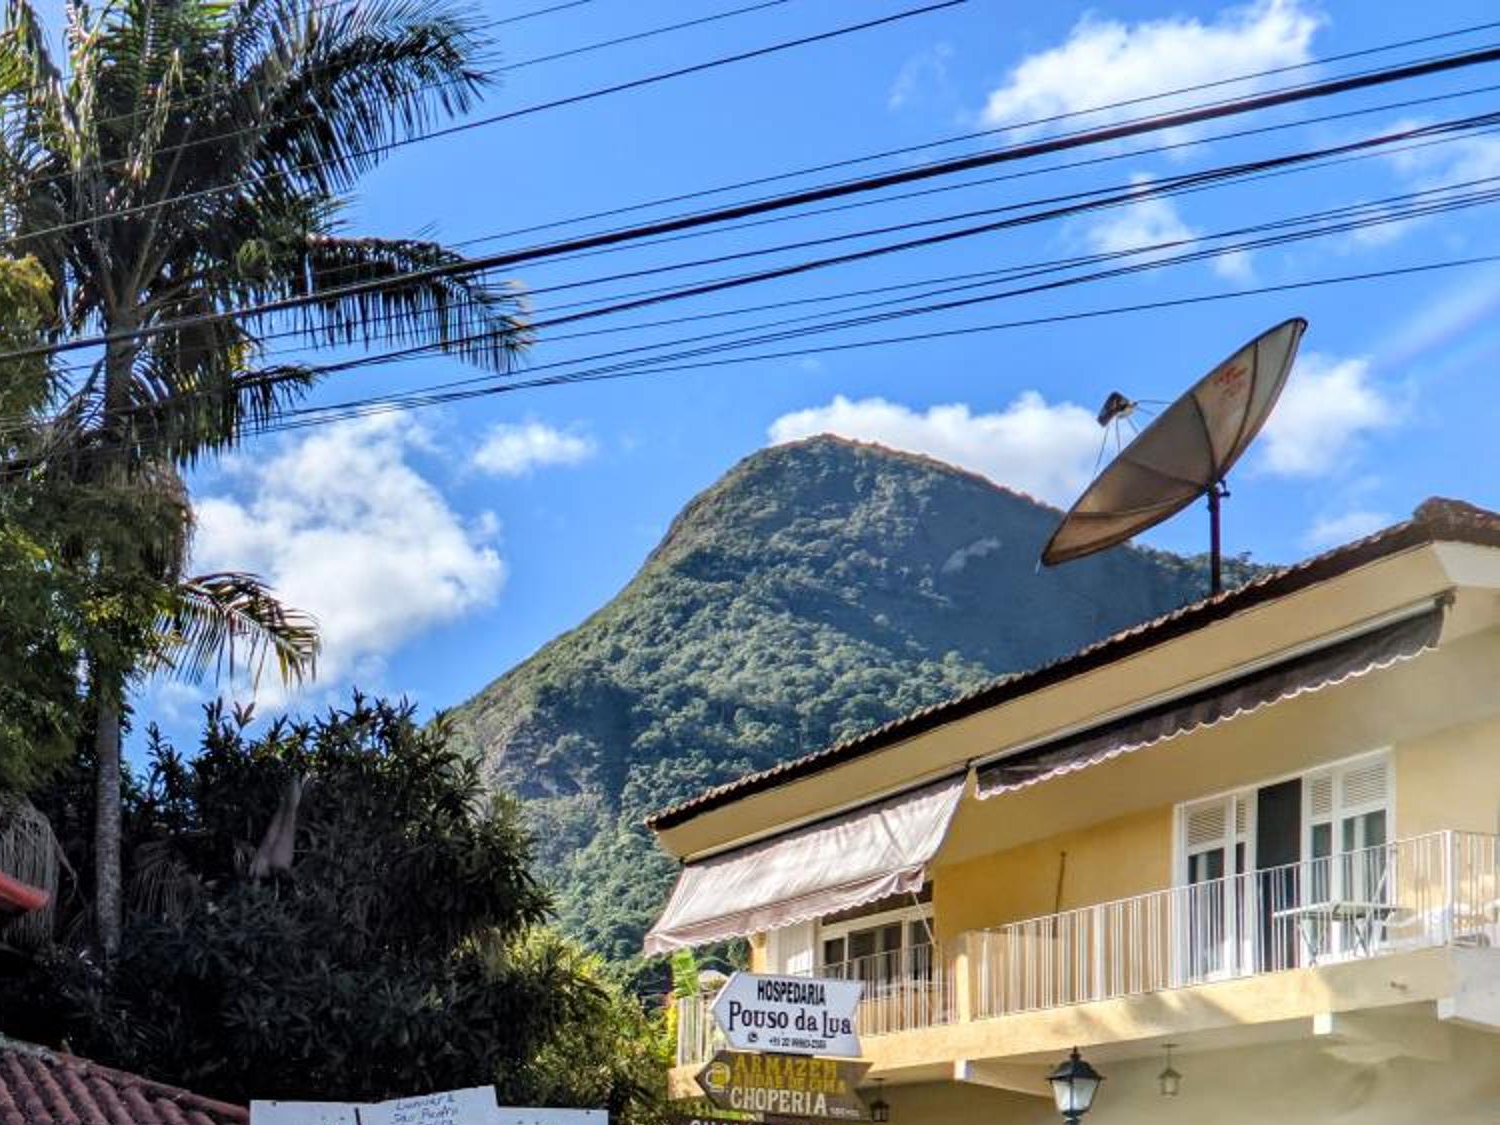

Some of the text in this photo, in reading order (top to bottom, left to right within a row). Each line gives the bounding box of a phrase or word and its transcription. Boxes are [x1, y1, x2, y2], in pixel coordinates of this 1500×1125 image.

[758, 980, 825, 1005] HOSPEDARIA
[729, 1001, 852, 1038] Pouso da Lua
[730, 1087, 827, 1116] CHOPERIA
